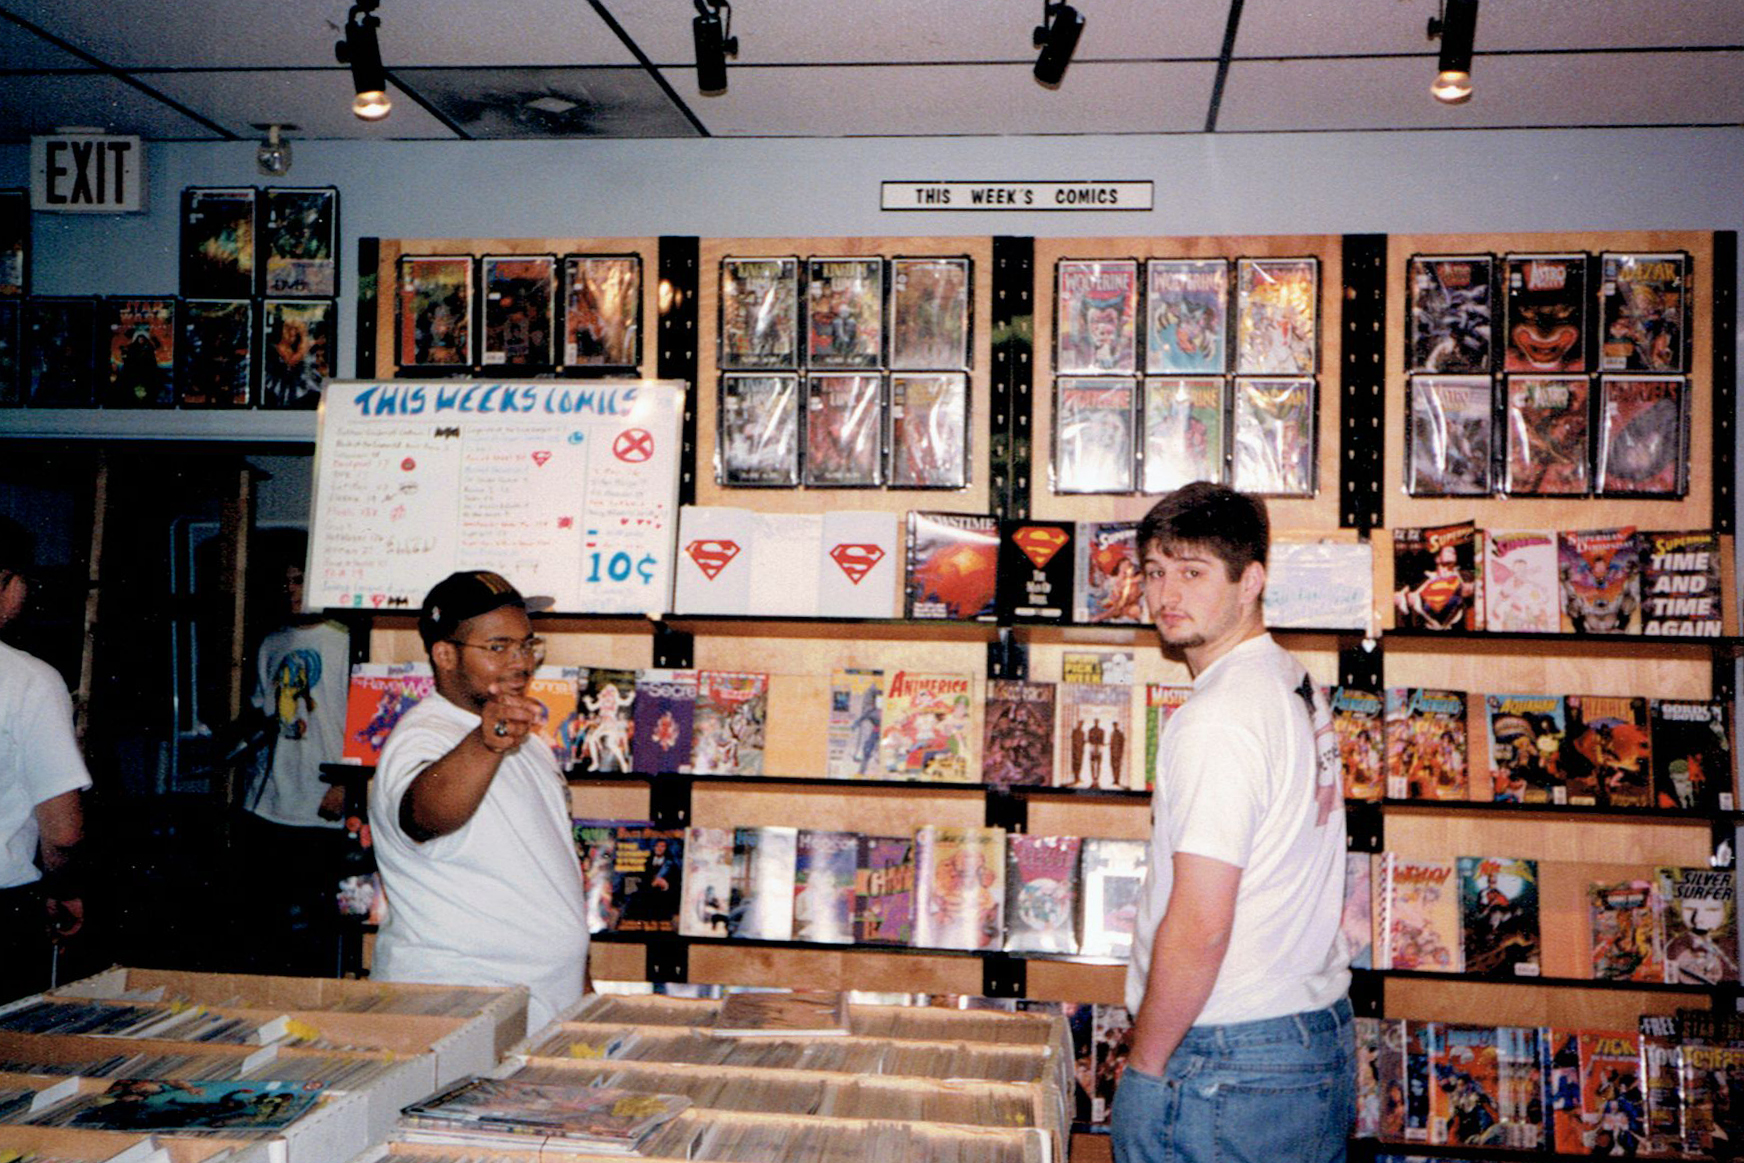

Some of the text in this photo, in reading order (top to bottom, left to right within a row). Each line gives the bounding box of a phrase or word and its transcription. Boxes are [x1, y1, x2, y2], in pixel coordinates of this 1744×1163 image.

[46, 142, 131, 204] EXIT
[915, 188, 1119, 205] THIS WEEK'S COMICS
[1064, 272, 1132, 292] WOLVERINE
[353, 383, 639, 417] THIS WEEKS COMICS
[924, 514, 996, 531] EWSTIME
[585, 551, 659, 585] 10¢
[1651, 552, 1711, 571] TIME
[1653, 575, 1707, 593] AND
[1652, 597, 1713, 616] TIME
[1644, 620, 1722, 637] AGAIN
[888, 670, 968, 699] ANIMERICA
[1684, 871, 1732, 886] SILVER
[1673, 885, 1733, 900] SURFER
